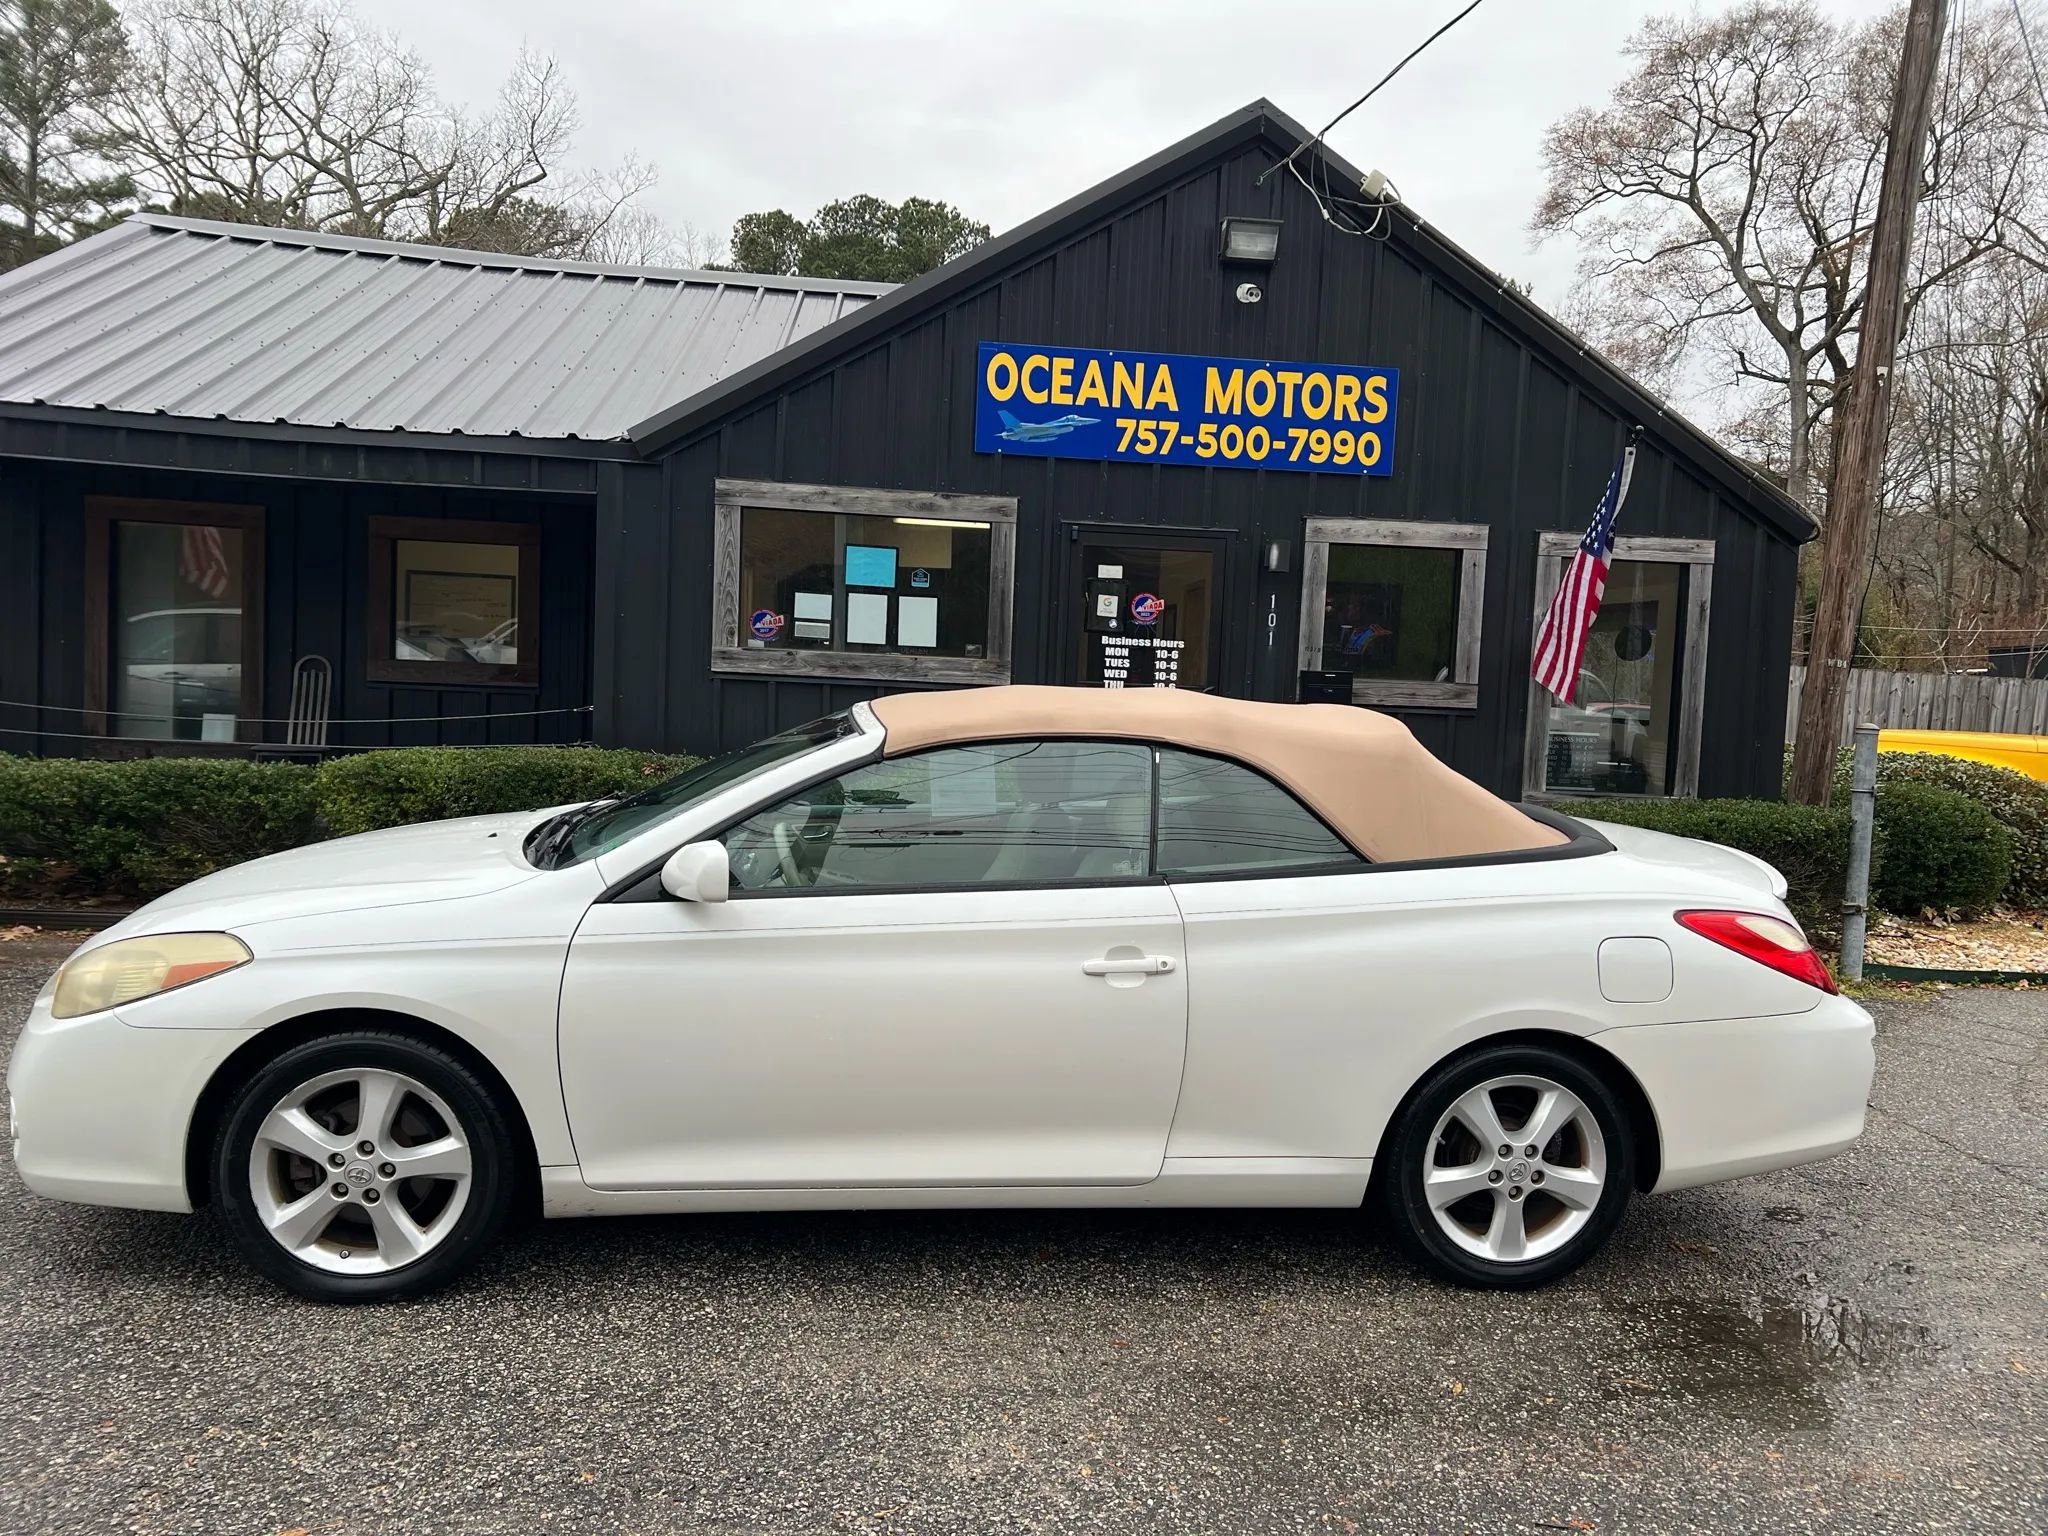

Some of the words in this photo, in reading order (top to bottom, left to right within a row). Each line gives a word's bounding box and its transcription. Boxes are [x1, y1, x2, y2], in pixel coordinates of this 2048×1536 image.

[986, 352, 1179, 412] OCEANA
[1204, 366, 1388, 424] MOTORS
[1115, 418, 1382, 467] 757-500-7990
[1101, 636, 1151, 647] Business
[1152, 638, 1185, 649] Hours
[1105, 647, 1129, 657] MON
[1155, 650, 1179, 660] 10-6
[1104, 658, 1130, 668] TUES
[1154, 661, 1178, 670] 10-6
[1104, 669, 1128, 679] WED
[1153, 672, 1177, 681] 10-6
